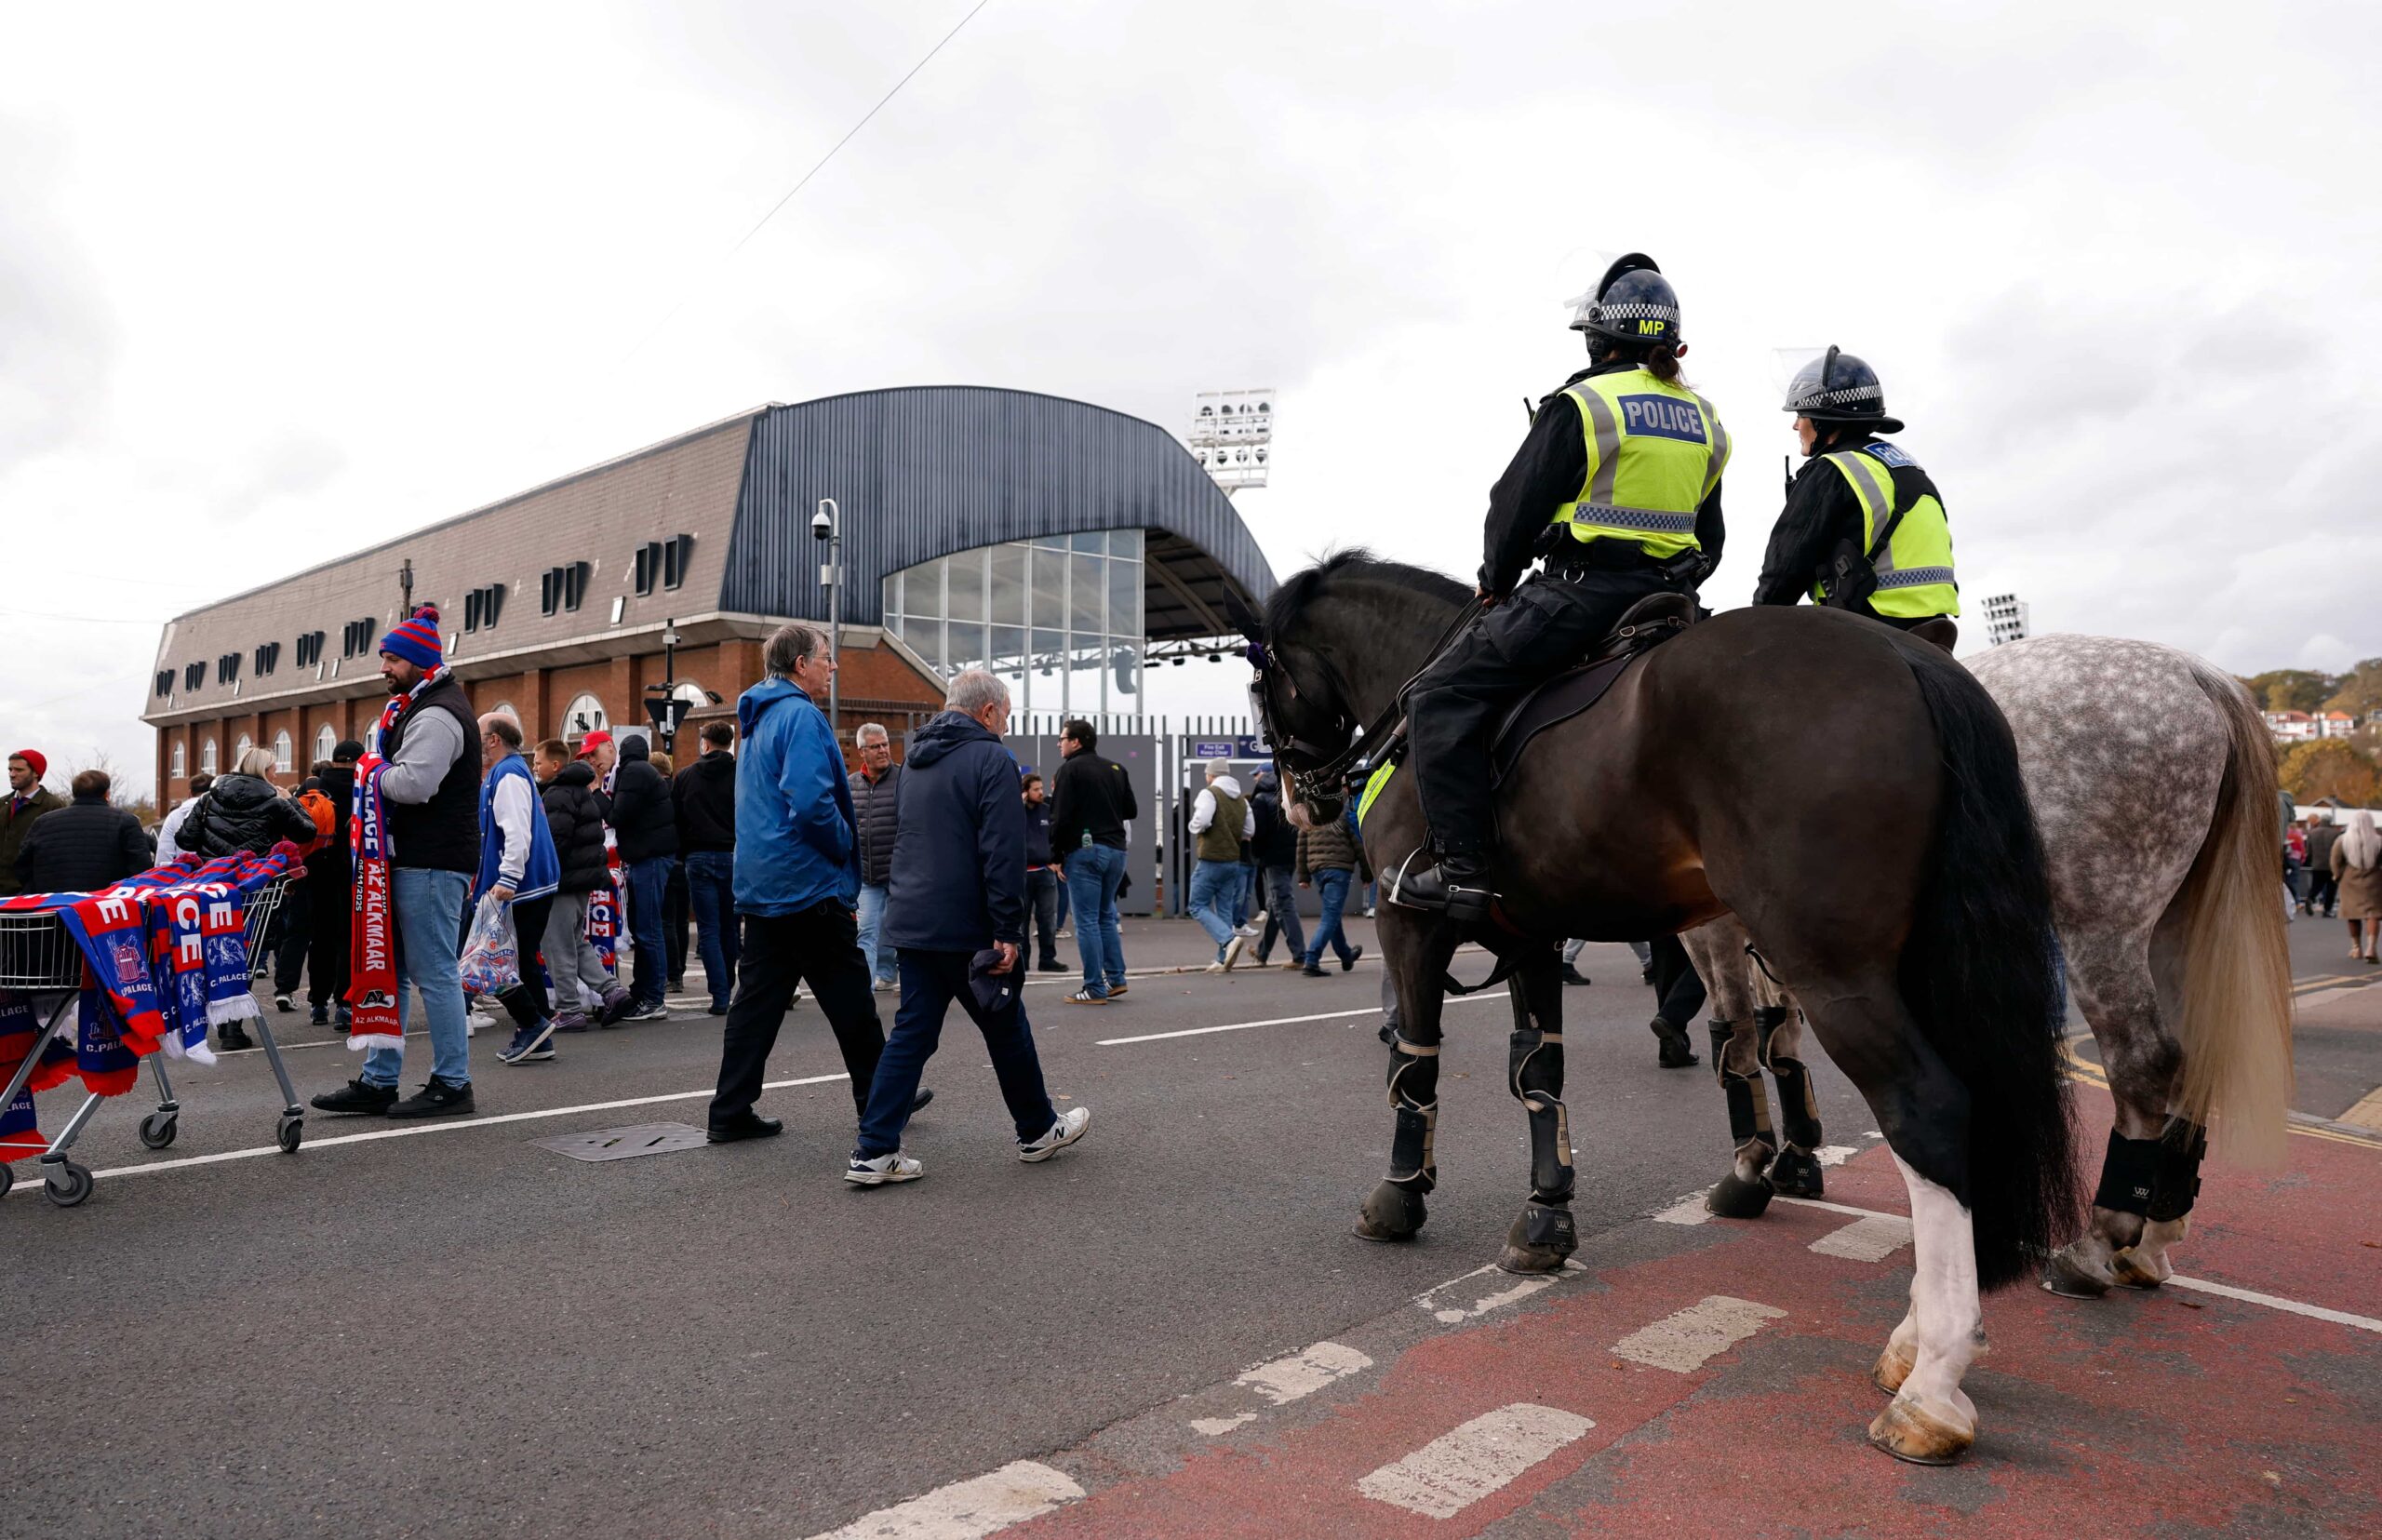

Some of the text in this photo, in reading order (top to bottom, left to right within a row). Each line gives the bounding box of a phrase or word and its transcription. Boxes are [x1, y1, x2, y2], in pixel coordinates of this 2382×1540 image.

[1639, 319, 1665, 336] MP
[1626, 400, 1703, 435] POLICE
[365, 771, 385, 971] PALACE AZ ALKMAAR
[219, 972, 247, 984] PALACE
[0, 1005, 29, 1017] LACE
[367, 1015, 399, 1026] ALKMAAR
[86, 1040, 124, 1052] C.PALA
[1053, 1126, 1064, 1140] N
[887, 1158, 900, 1172] N
